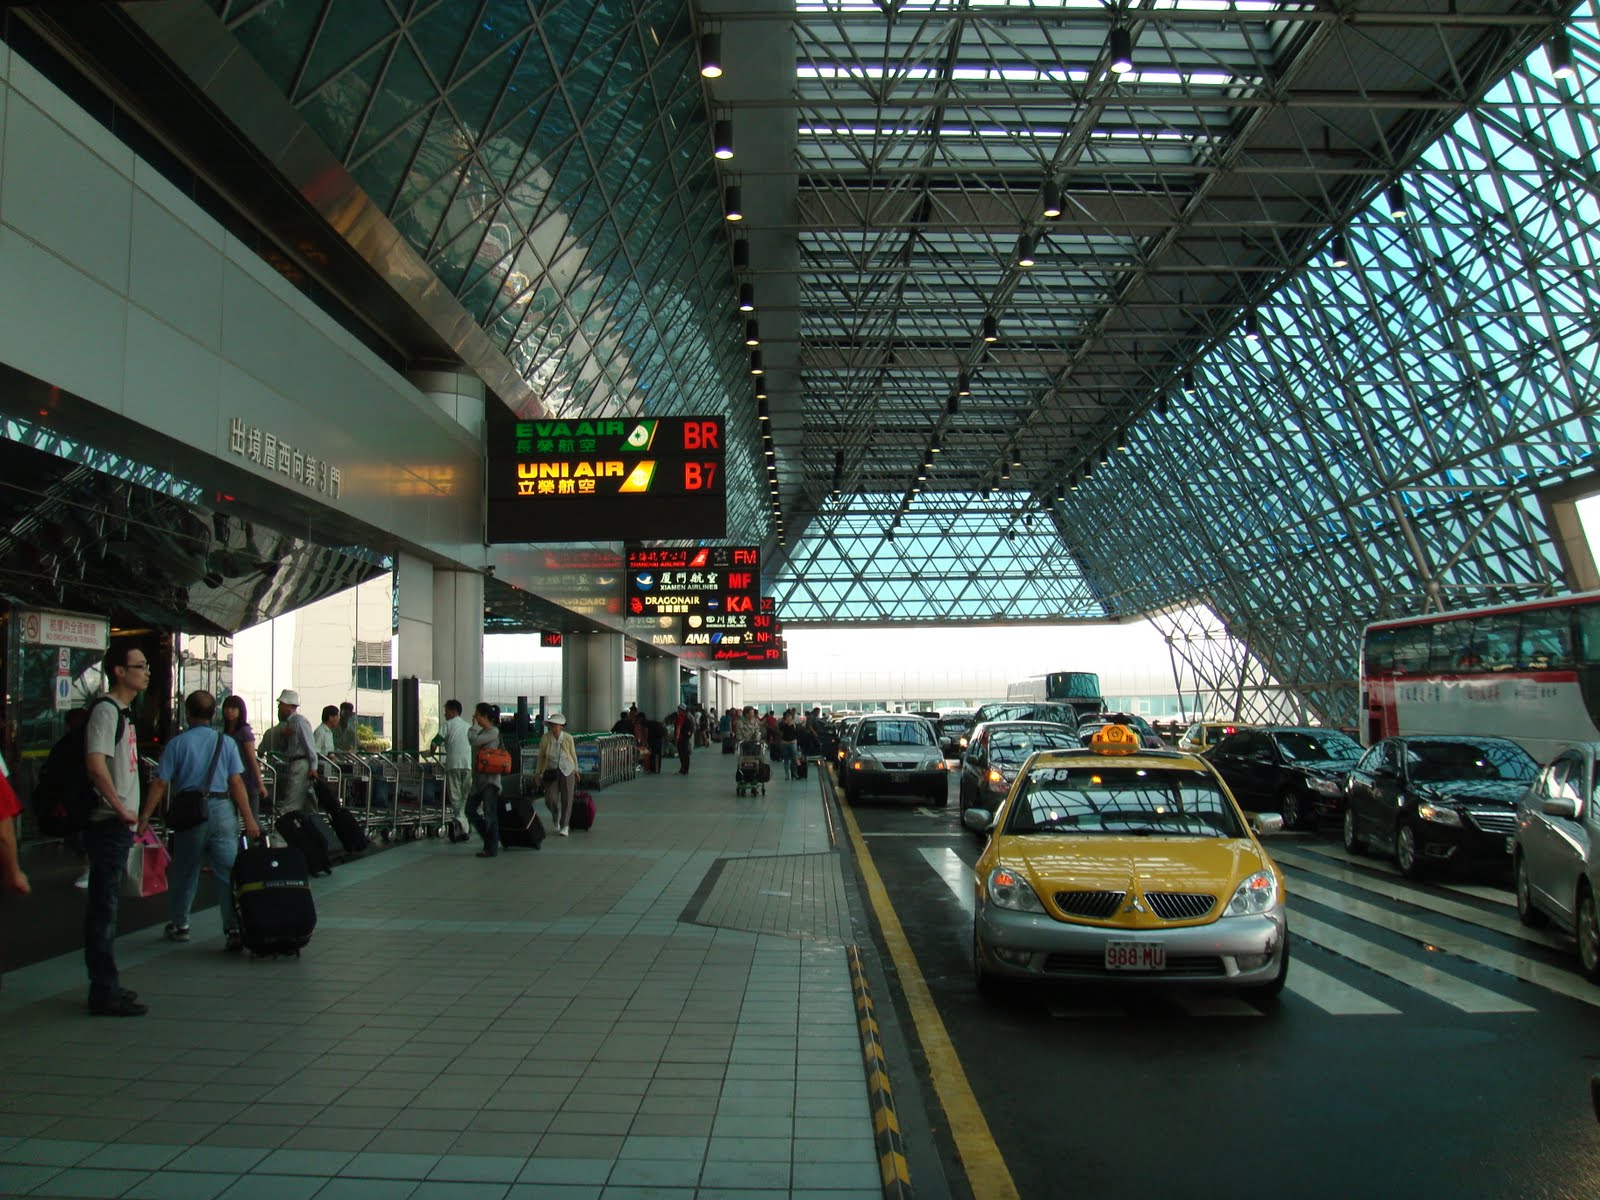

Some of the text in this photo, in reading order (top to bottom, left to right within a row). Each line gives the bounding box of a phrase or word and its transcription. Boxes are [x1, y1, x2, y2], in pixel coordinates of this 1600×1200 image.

[515, 421, 624, 437] EVA AIR
[683, 421, 718, 449] BR
[516, 439, 596, 453] 長榮航空
[230, 417, 341, 499] 出境層西向第3門
[518, 461, 625, 479] UNI AIR
[684, 462, 717, 490] B7
[518, 479, 596, 495] 立榮航空
[734, 550, 757, 564] FM
[729, 573, 751, 589] MF
[645, 596, 700, 605] DRAGONAIR
[726, 596, 754, 612] KA
[706, 615, 747, 624] 四川航空
[754, 615, 770, 627] 3U
[685, 634, 710, 645] ANA
[721, 636, 741, 645] 全日空
[756, 631, 772, 643] NH
[766, 649, 780, 660] FD
